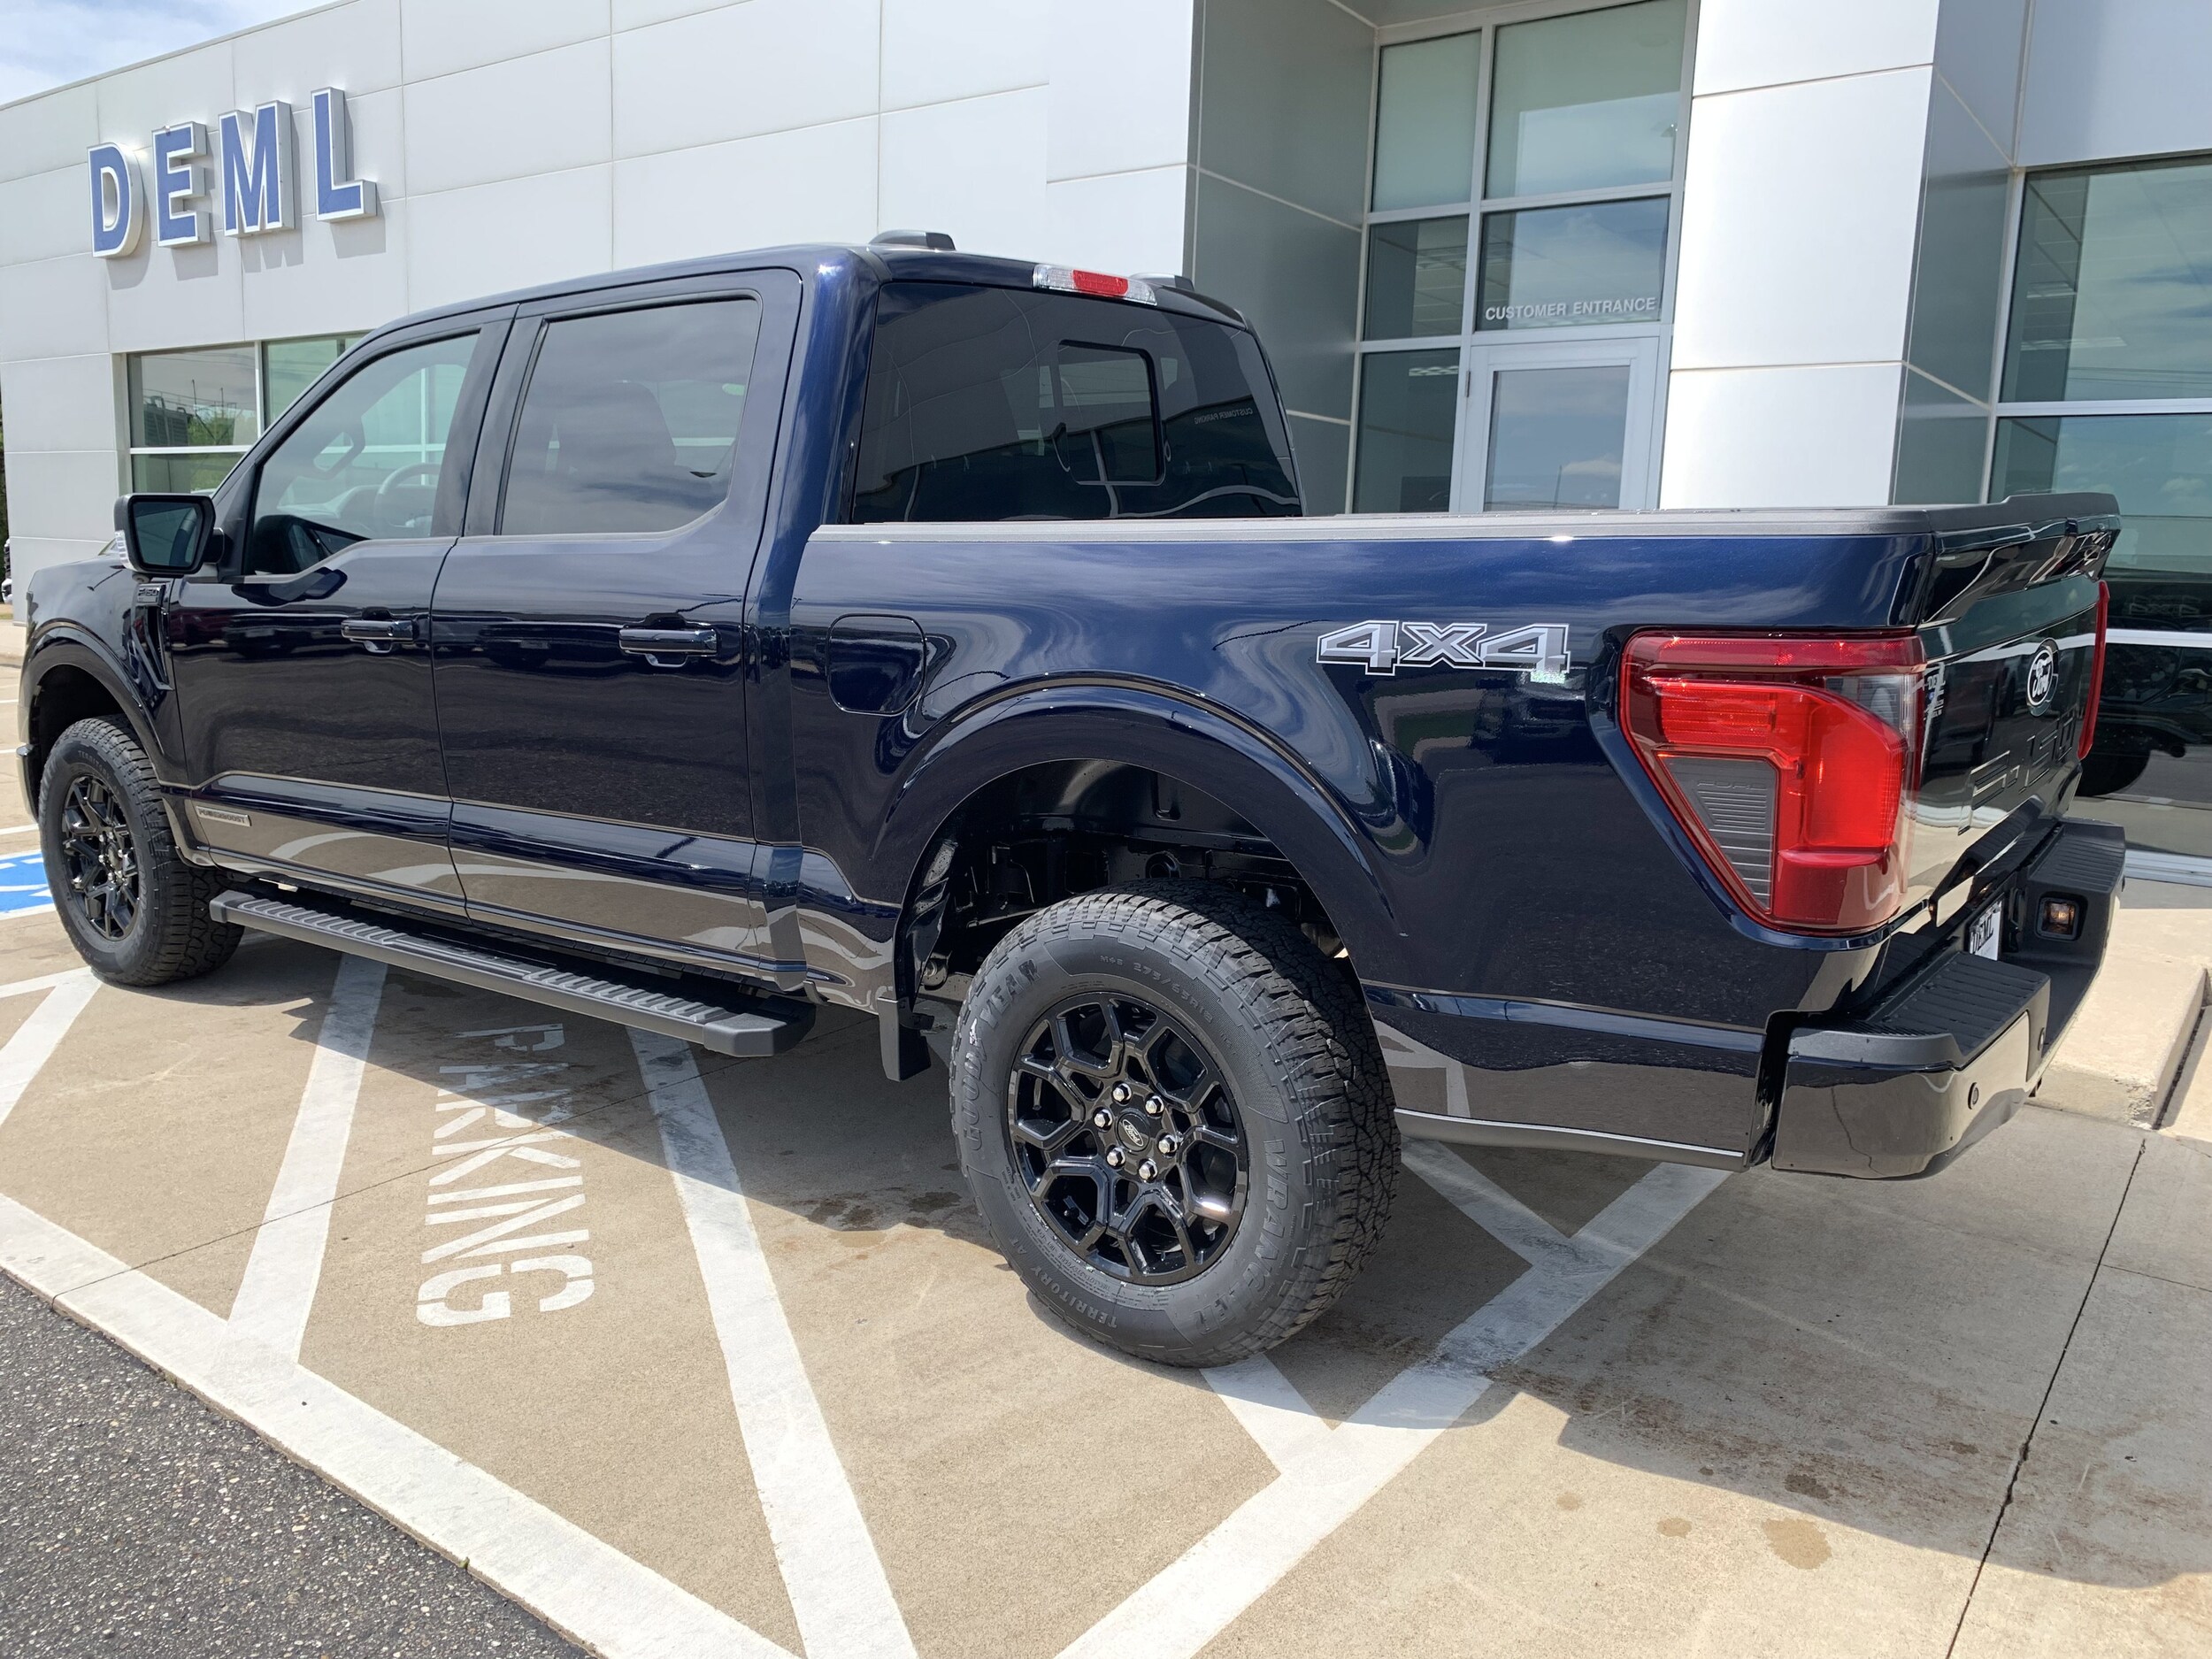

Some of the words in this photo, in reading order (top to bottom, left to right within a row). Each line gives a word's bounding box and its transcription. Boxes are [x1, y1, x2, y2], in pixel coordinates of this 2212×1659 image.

[87, 87, 376, 257] DEML
[1485, 302, 1566, 320] CUSTOMER
[1573, 296, 1656, 315] ENTRANCE
[1697, 780, 1768, 791] FORD
[1123, 1123, 1141, 1144] Ford
[416, 1024, 595, 1327] PARKING
[1191, 1139, 1289, 1335] WRANGLER
[1030, 1266, 1118, 1329] TERRITORY
